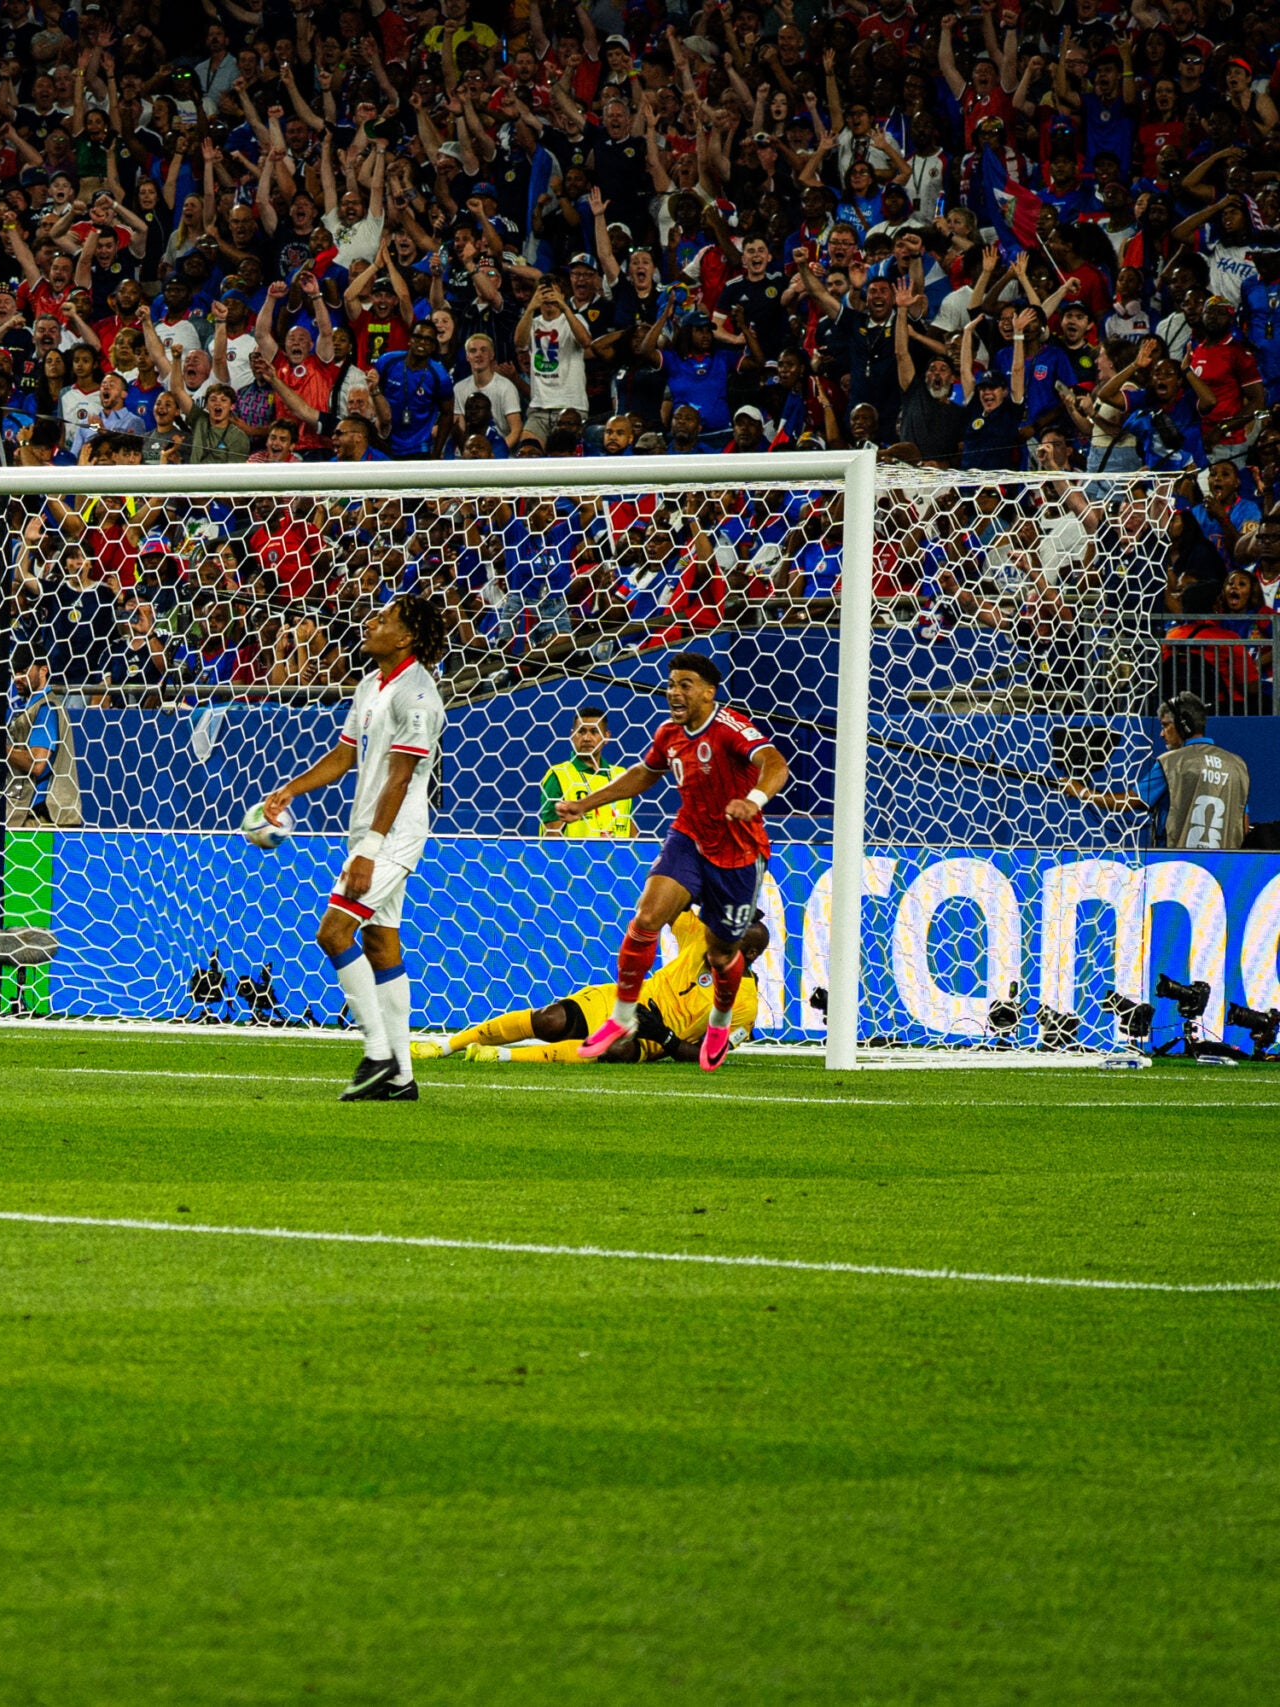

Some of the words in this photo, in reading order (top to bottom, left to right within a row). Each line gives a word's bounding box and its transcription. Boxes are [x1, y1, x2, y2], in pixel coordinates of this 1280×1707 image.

[1217, 257, 1254, 278] HAITI
[361, 734, 369, 763] 9
[1204, 755, 1223, 769] HB
[1201, 768, 1230, 786] 1097
[721, 904, 752, 927] 10
